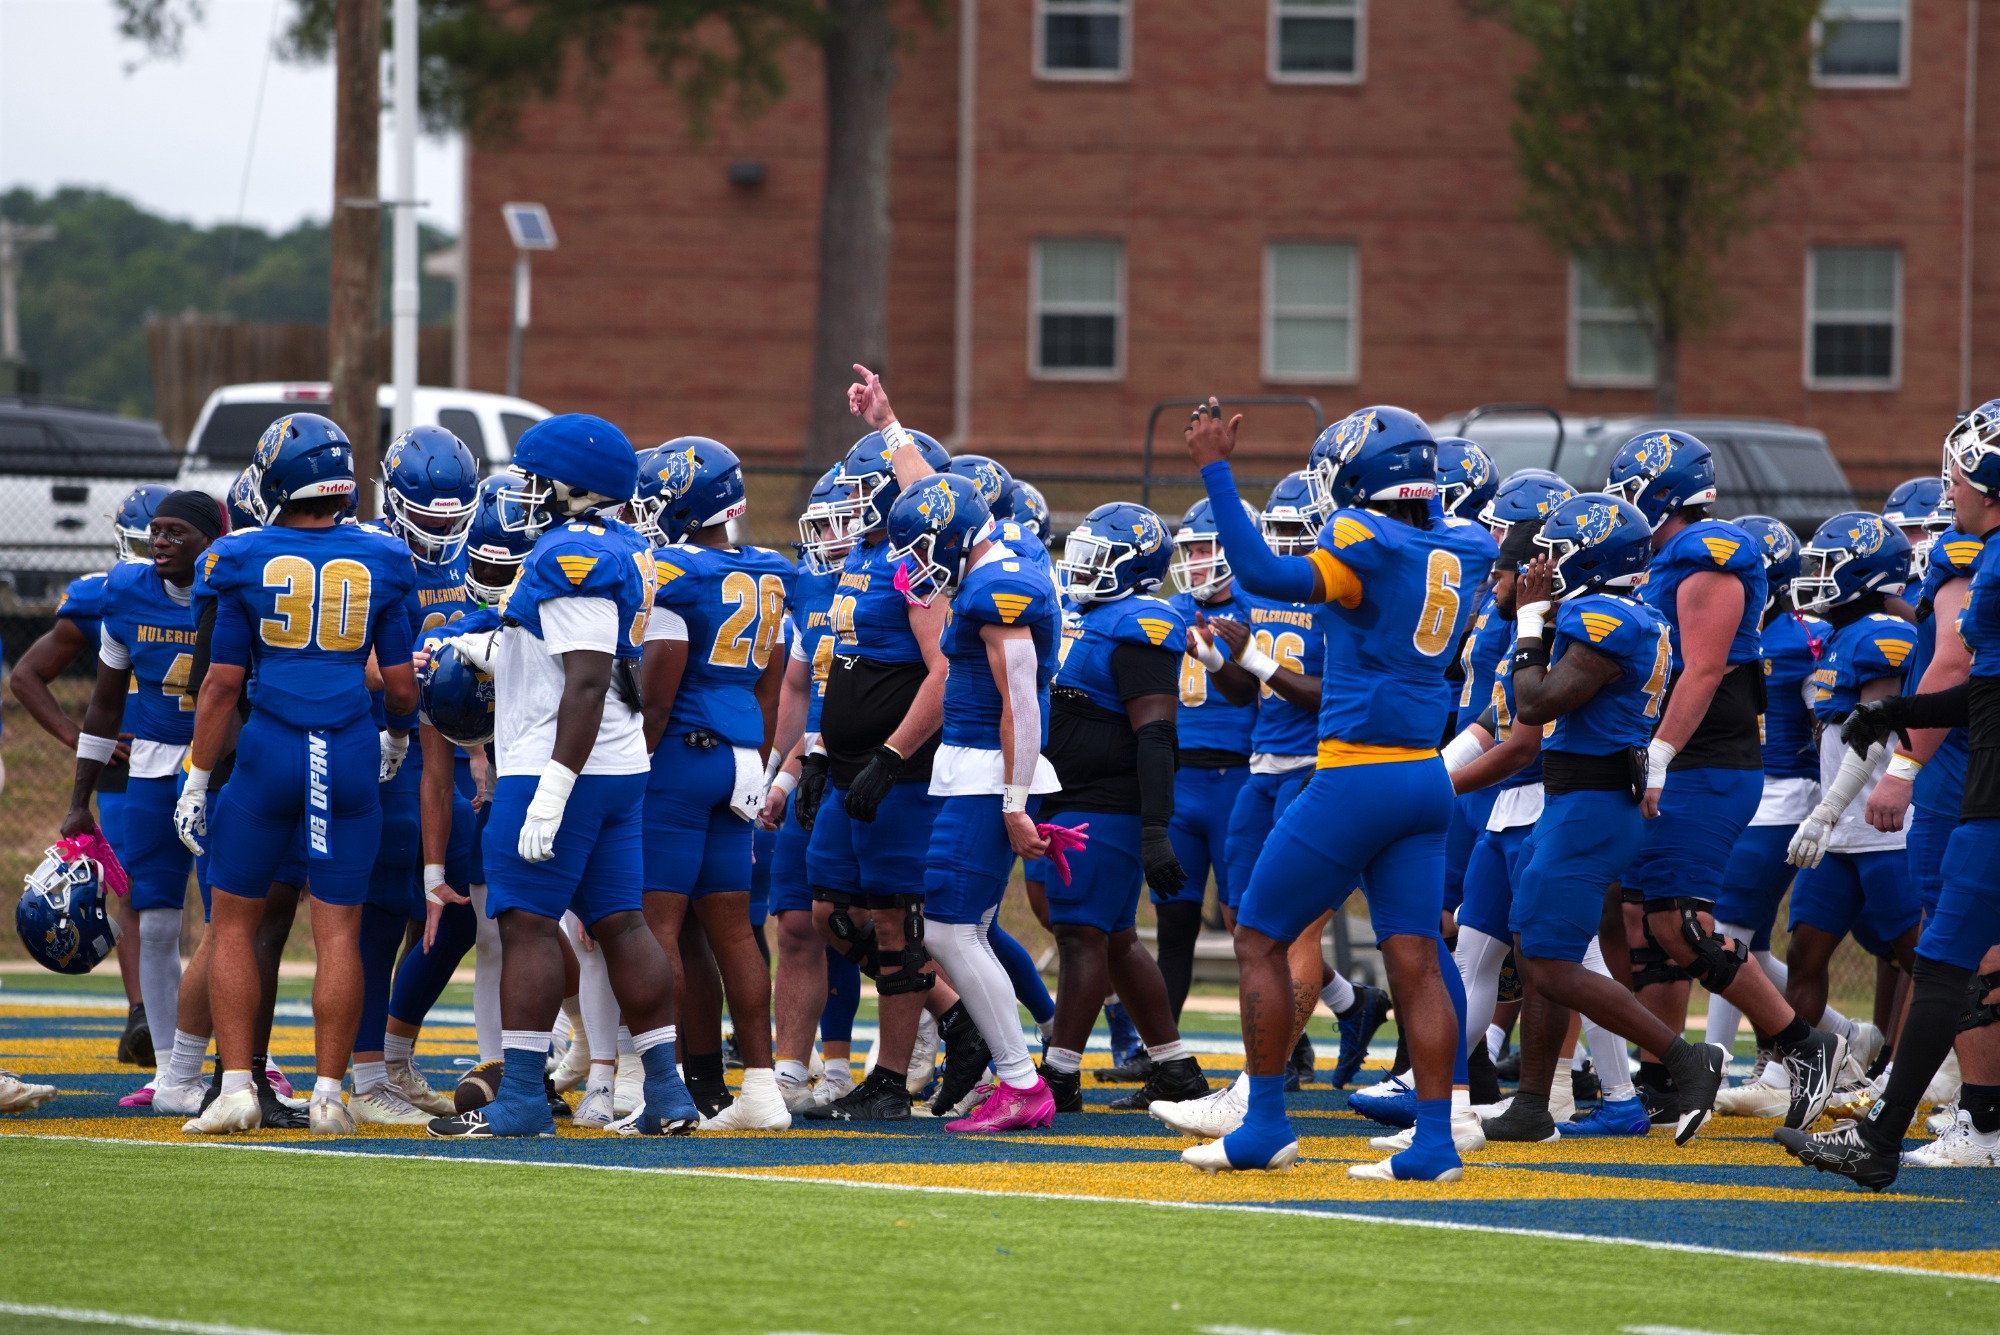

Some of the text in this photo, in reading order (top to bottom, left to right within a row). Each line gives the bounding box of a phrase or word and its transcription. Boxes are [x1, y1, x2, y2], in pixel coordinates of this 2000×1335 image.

[331, 447, 341, 457] 30
[260, 555, 372, 652] 30
[708, 571, 786, 669] 28
[1251, 608, 1313, 630] MULERIDERS
[1412, 549, 1462, 657] 6
[310, 814, 328, 854] BE
